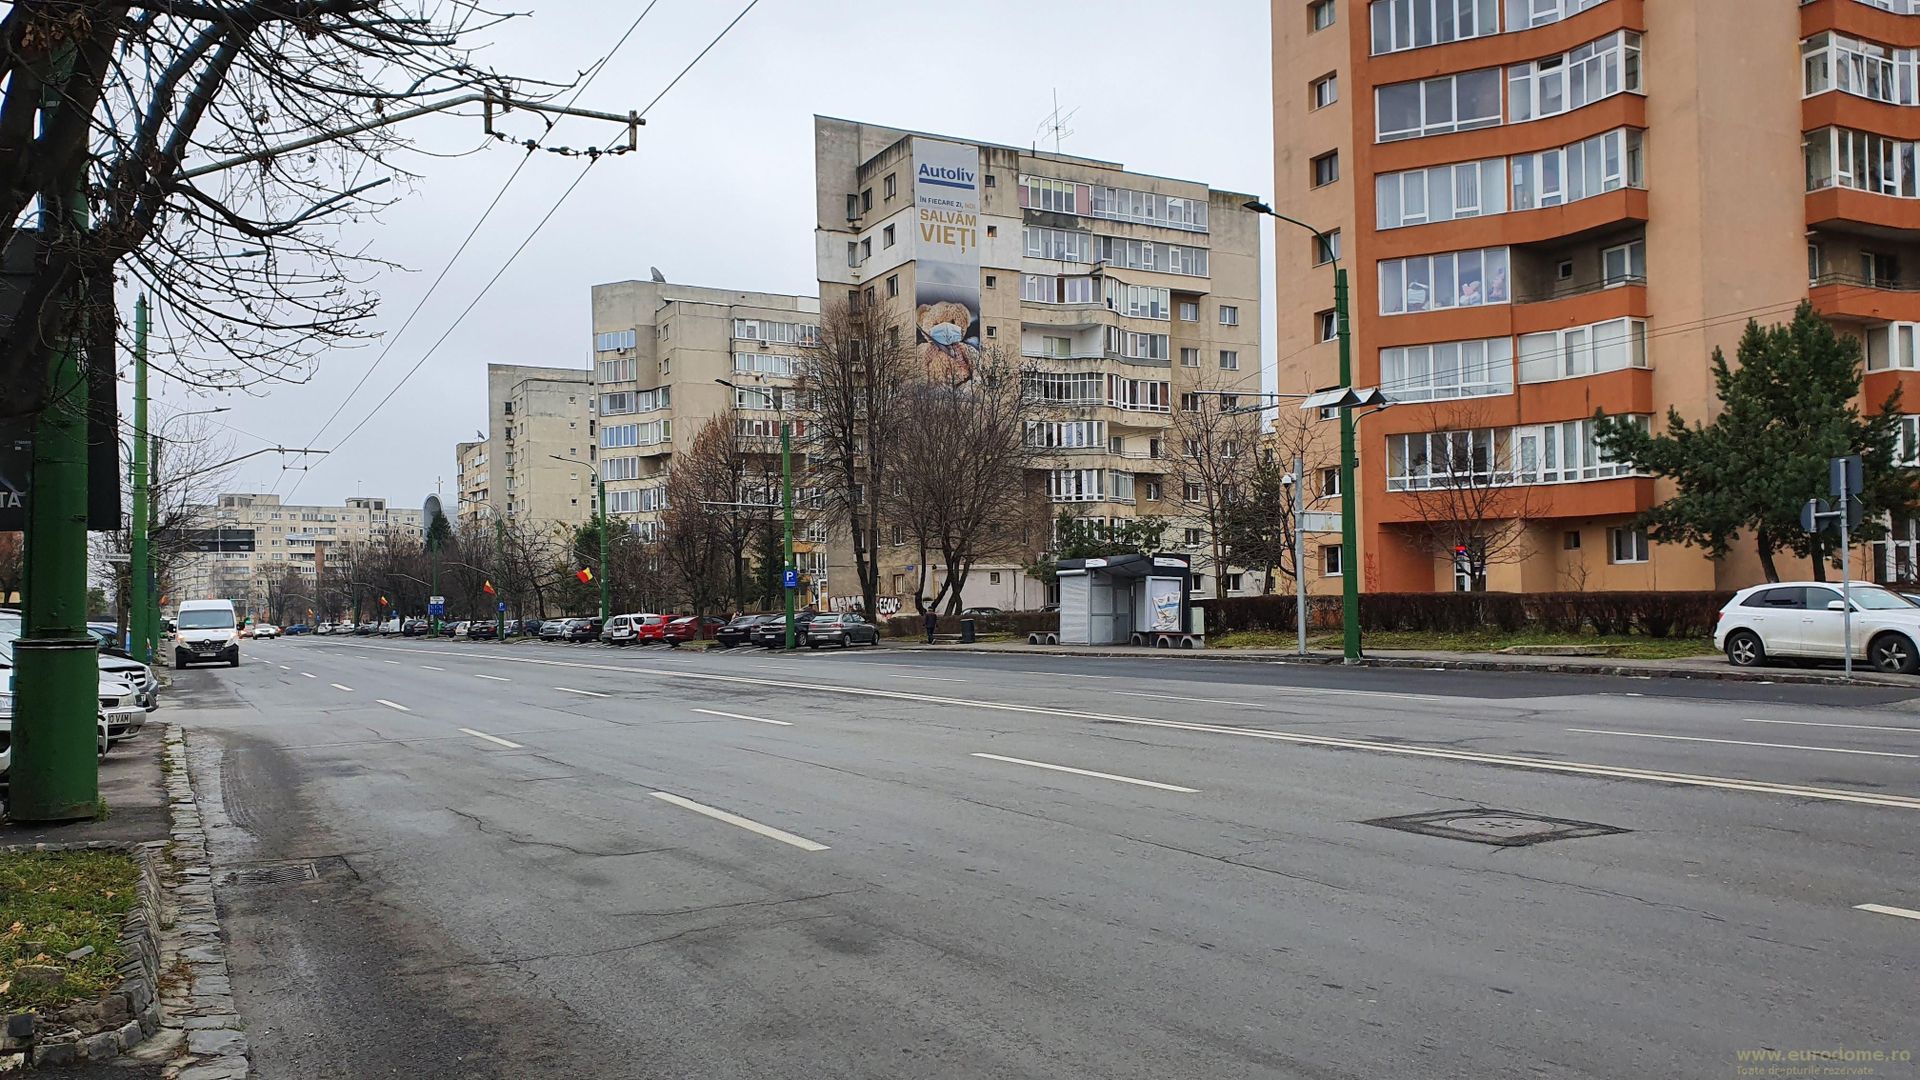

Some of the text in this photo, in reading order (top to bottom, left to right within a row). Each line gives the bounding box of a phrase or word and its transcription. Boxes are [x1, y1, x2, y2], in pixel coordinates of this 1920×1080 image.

[919, 163, 974, 182] Autoliv
[920, 195, 927, 203] ÎN
[928, 197, 955, 206] FIECARE
[956, 201, 964, 209] ZI,
[920, 208, 976, 227] SALVĂM
[920, 222, 976, 254] VIEȚI
[786, 571, 794, 581] P
[115, 713, 129, 723] VAM
